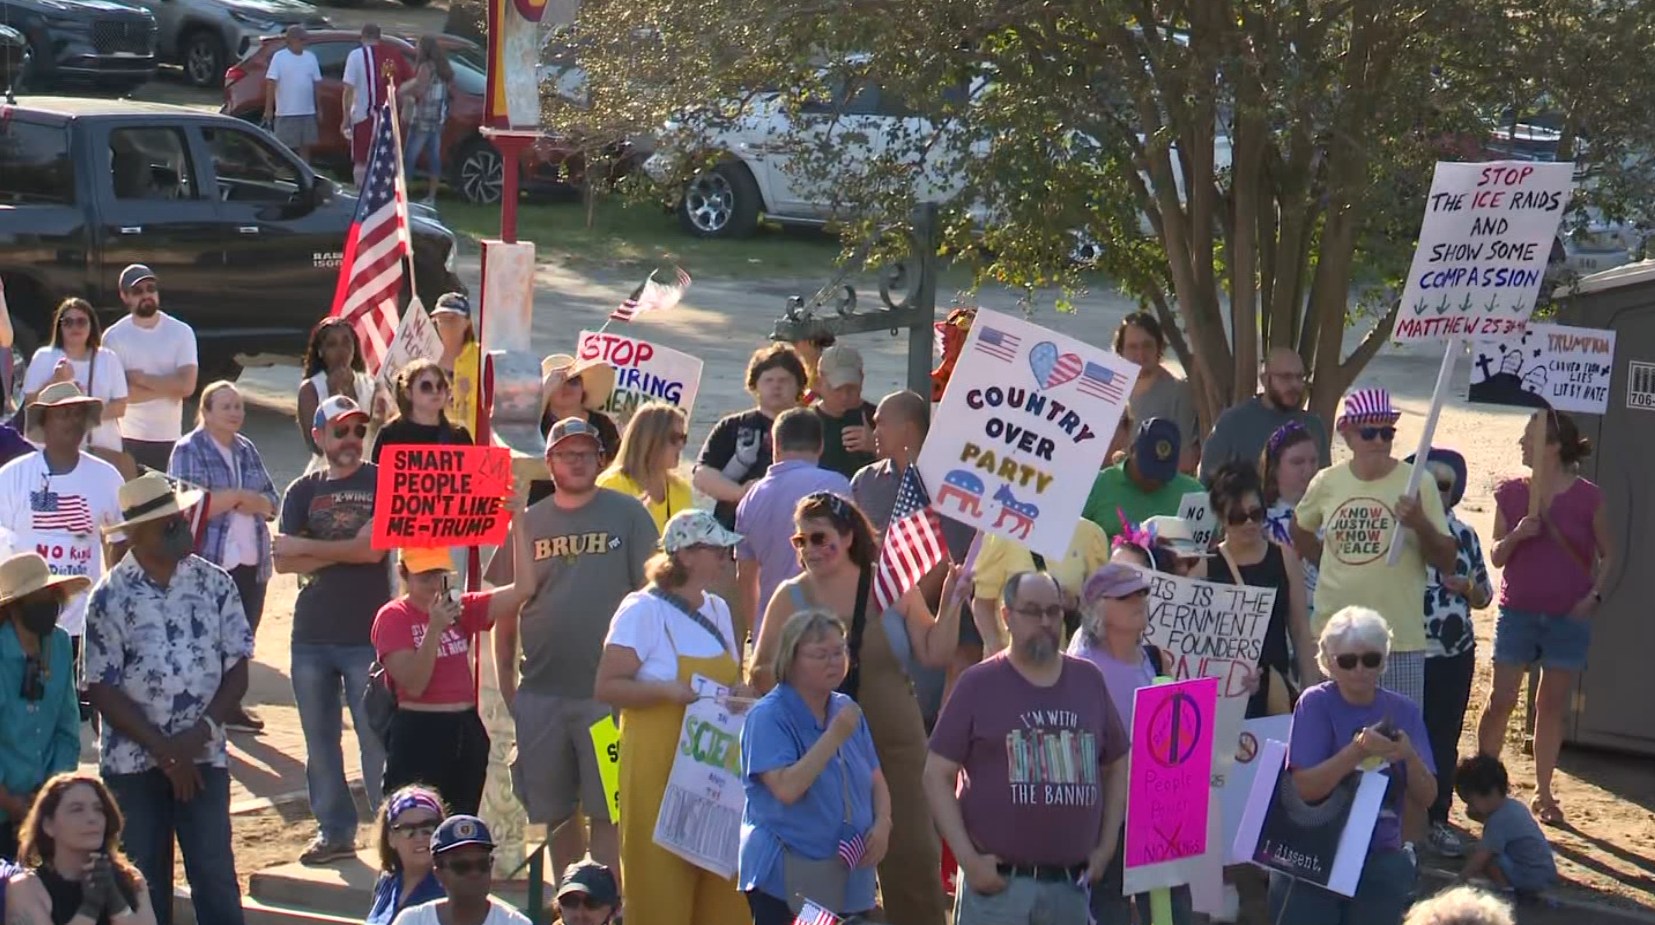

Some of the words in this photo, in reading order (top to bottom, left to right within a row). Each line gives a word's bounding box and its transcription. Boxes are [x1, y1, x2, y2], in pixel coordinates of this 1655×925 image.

[1477, 166, 1534, 187] STOP
[1432, 192, 1468, 212] THE
[1471, 191, 1506, 210] ICE
[1509, 191, 1562, 212] RAIDS
[1470, 217, 1508, 237] AND
[1429, 243, 1484, 263] SHOW
[1485, 240, 1538, 261] SOME
[1419, 266, 1540, 290] COMPASSION
[1396, 316, 1480, 338] MATTHEW
[581, 335, 653, 367] STOP
[611, 366, 683, 406] IRING
[1569, 373, 1593, 383] LIES
[1553, 383, 1569, 397] LIT
[1583, 386, 1607, 402] HATE
[966, 386, 1095, 444] COUNTRY
[985, 417, 1056, 461] OVER
[394, 450, 465, 471] SMART
[960, 442, 1054, 494] PARTY
[393, 472, 472, 494] PEOPLE
[390, 494, 454, 516] DON'T
[458, 497, 500, 516] LIKE
[1186, 506, 1204, 520] NO
[1340, 507, 1382, 519] KNOW
[1331, 518, 1388, 530] JUSTICE
[534, 532, 608, 561] BRUH
[1336, 531, 1381, 542] KNOW
[36, 544, 64, 559] NO
[1187, 585, 1214, 607] IS
[1225, 589, 1272, 614] THE
[1147, 603, 1265, 638] VERNMENT
[1167, 630, 1262, 661] FOUNDERS
[1020, 710, 1045, 729] I'M
[1046, 710, 1078, 729] WITH
[1010, 784, 1037, 805] THE
[1044, 784, 1098, 806] BANNED
[1262, 839, 1271, 854] I
[1274, 843, 1321, 872] dissent.
